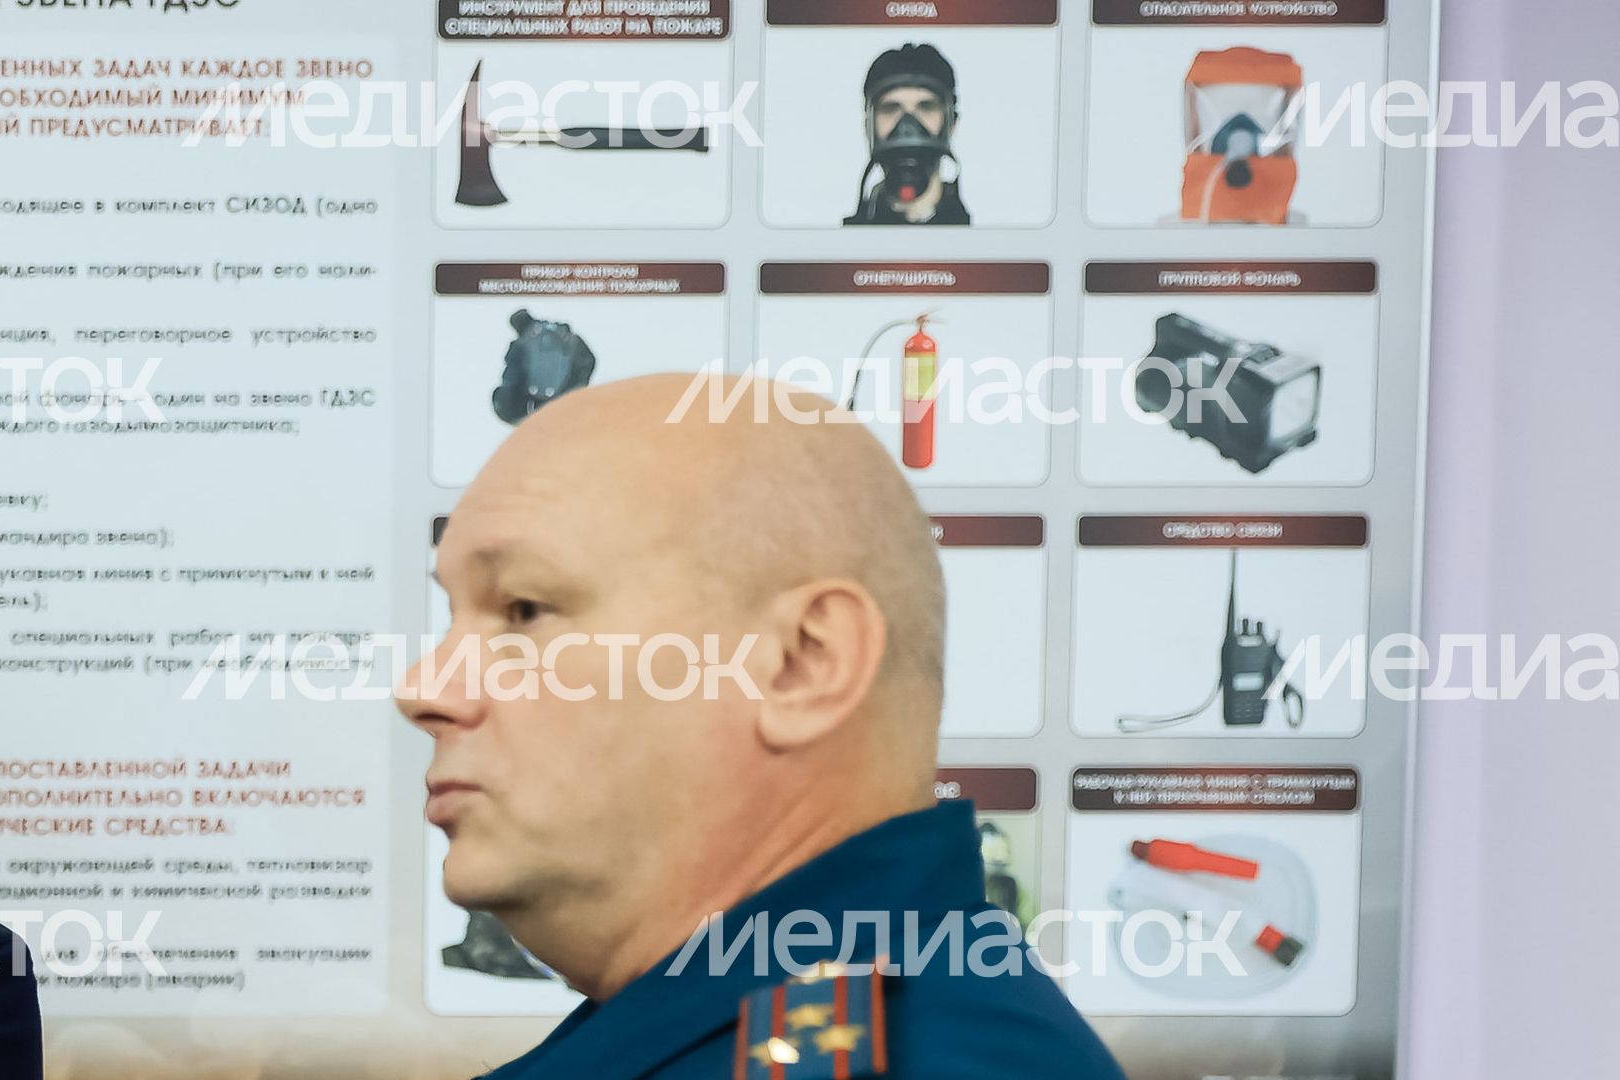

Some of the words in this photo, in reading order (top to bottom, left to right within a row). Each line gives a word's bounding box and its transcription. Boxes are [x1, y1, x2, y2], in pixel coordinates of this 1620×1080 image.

[93, 58, 172, 81] ЗАДАЧ
[180, 58, 285, 81] КАЖДОЕ
[295, 57, 374, 80] ЗВЕНО
[171, 87, 303, 107] МИНИМУМ
